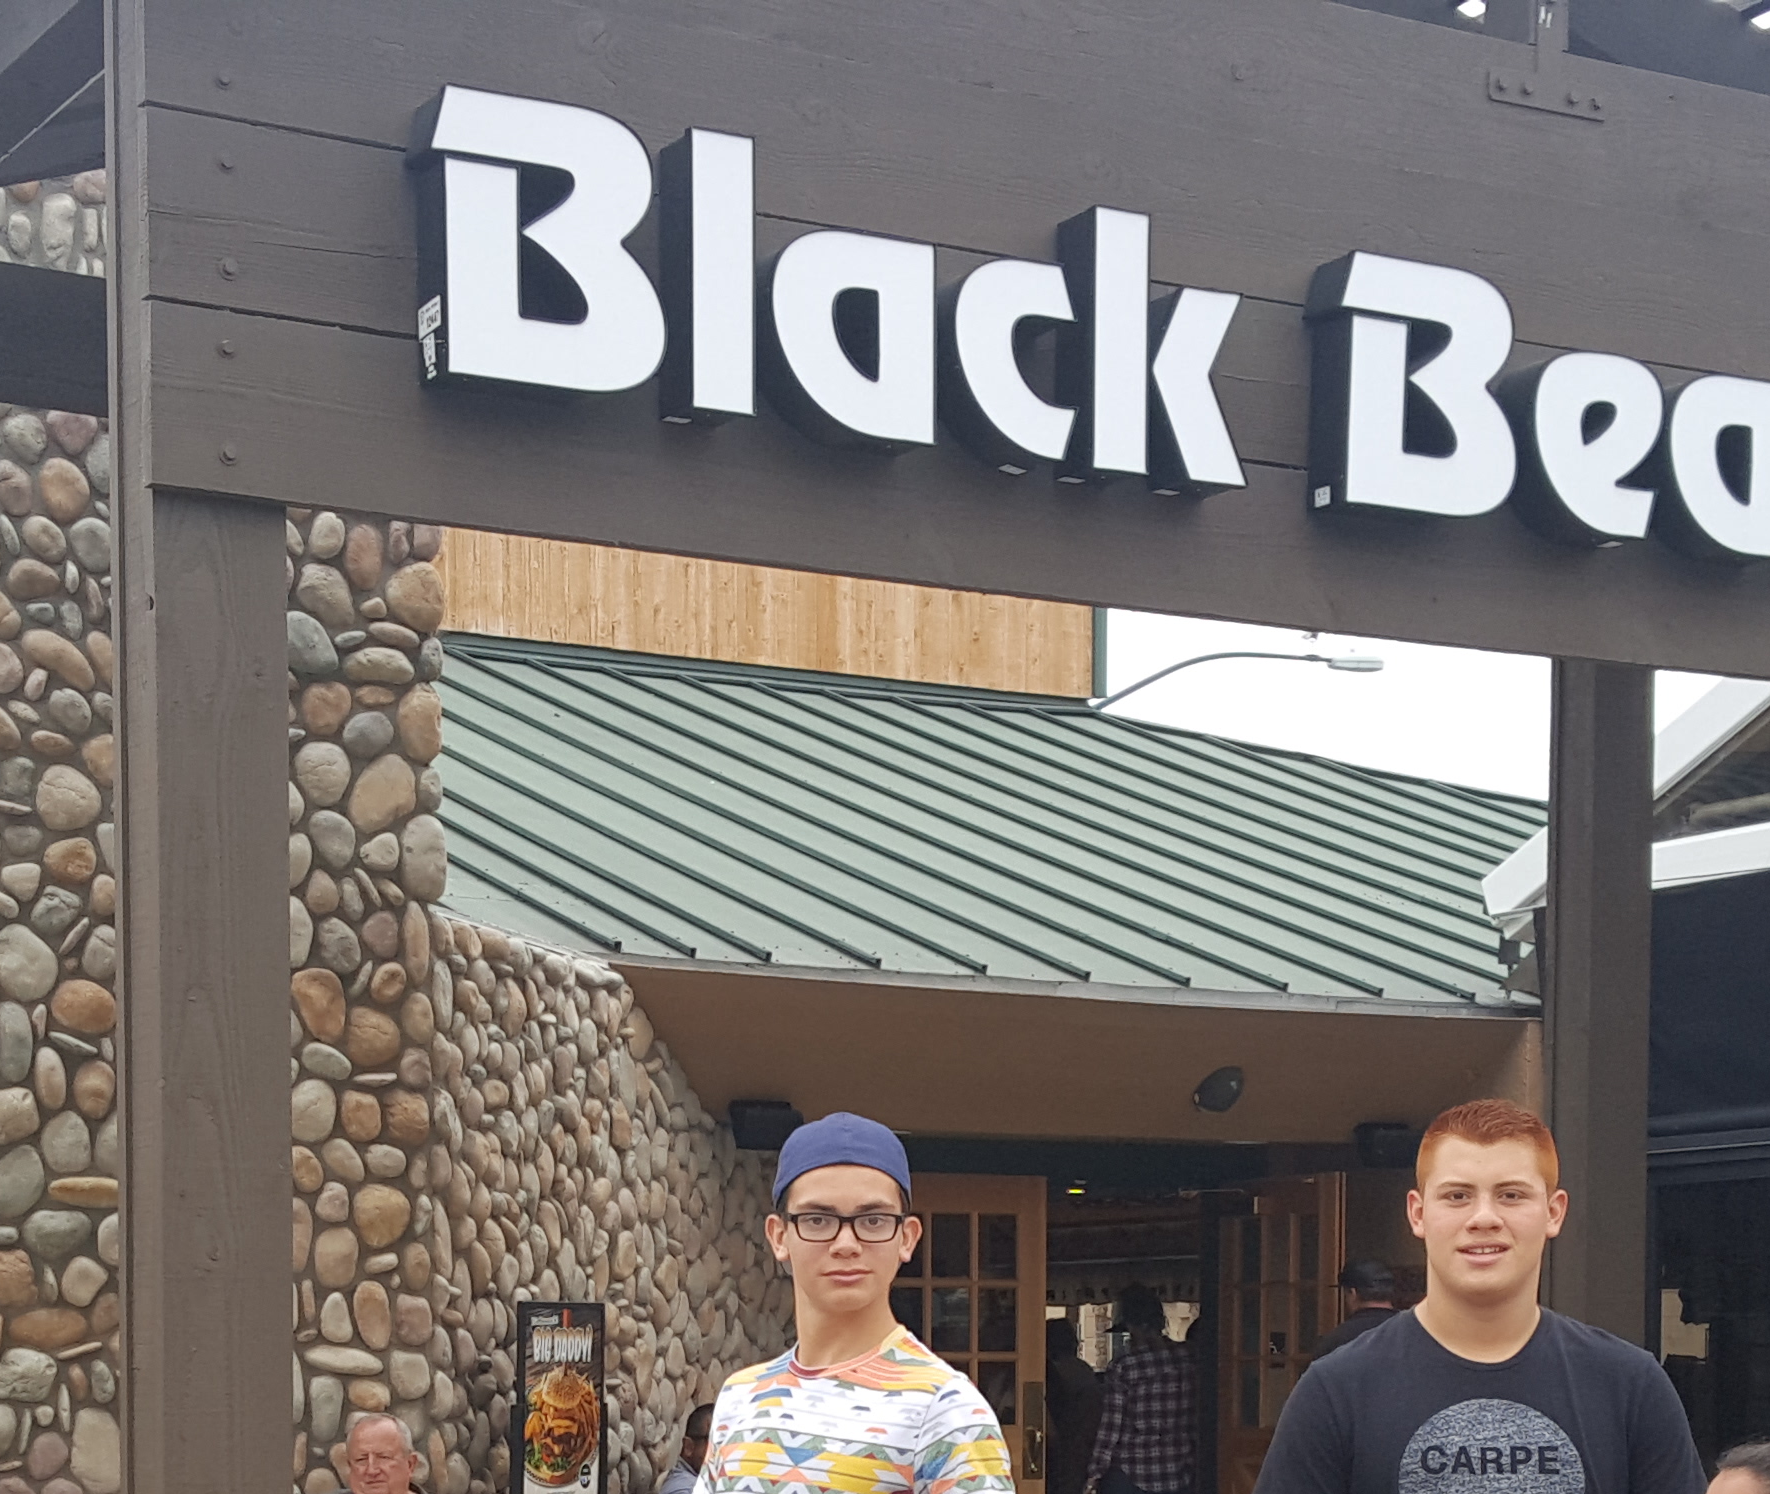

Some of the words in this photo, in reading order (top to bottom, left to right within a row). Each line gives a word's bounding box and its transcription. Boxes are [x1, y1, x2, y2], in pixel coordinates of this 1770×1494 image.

[431, 84, 1247, 488] Black
[533, 1326, 553, 1363] BIG
[1420, 1445, 1560, 1475] CARPE
